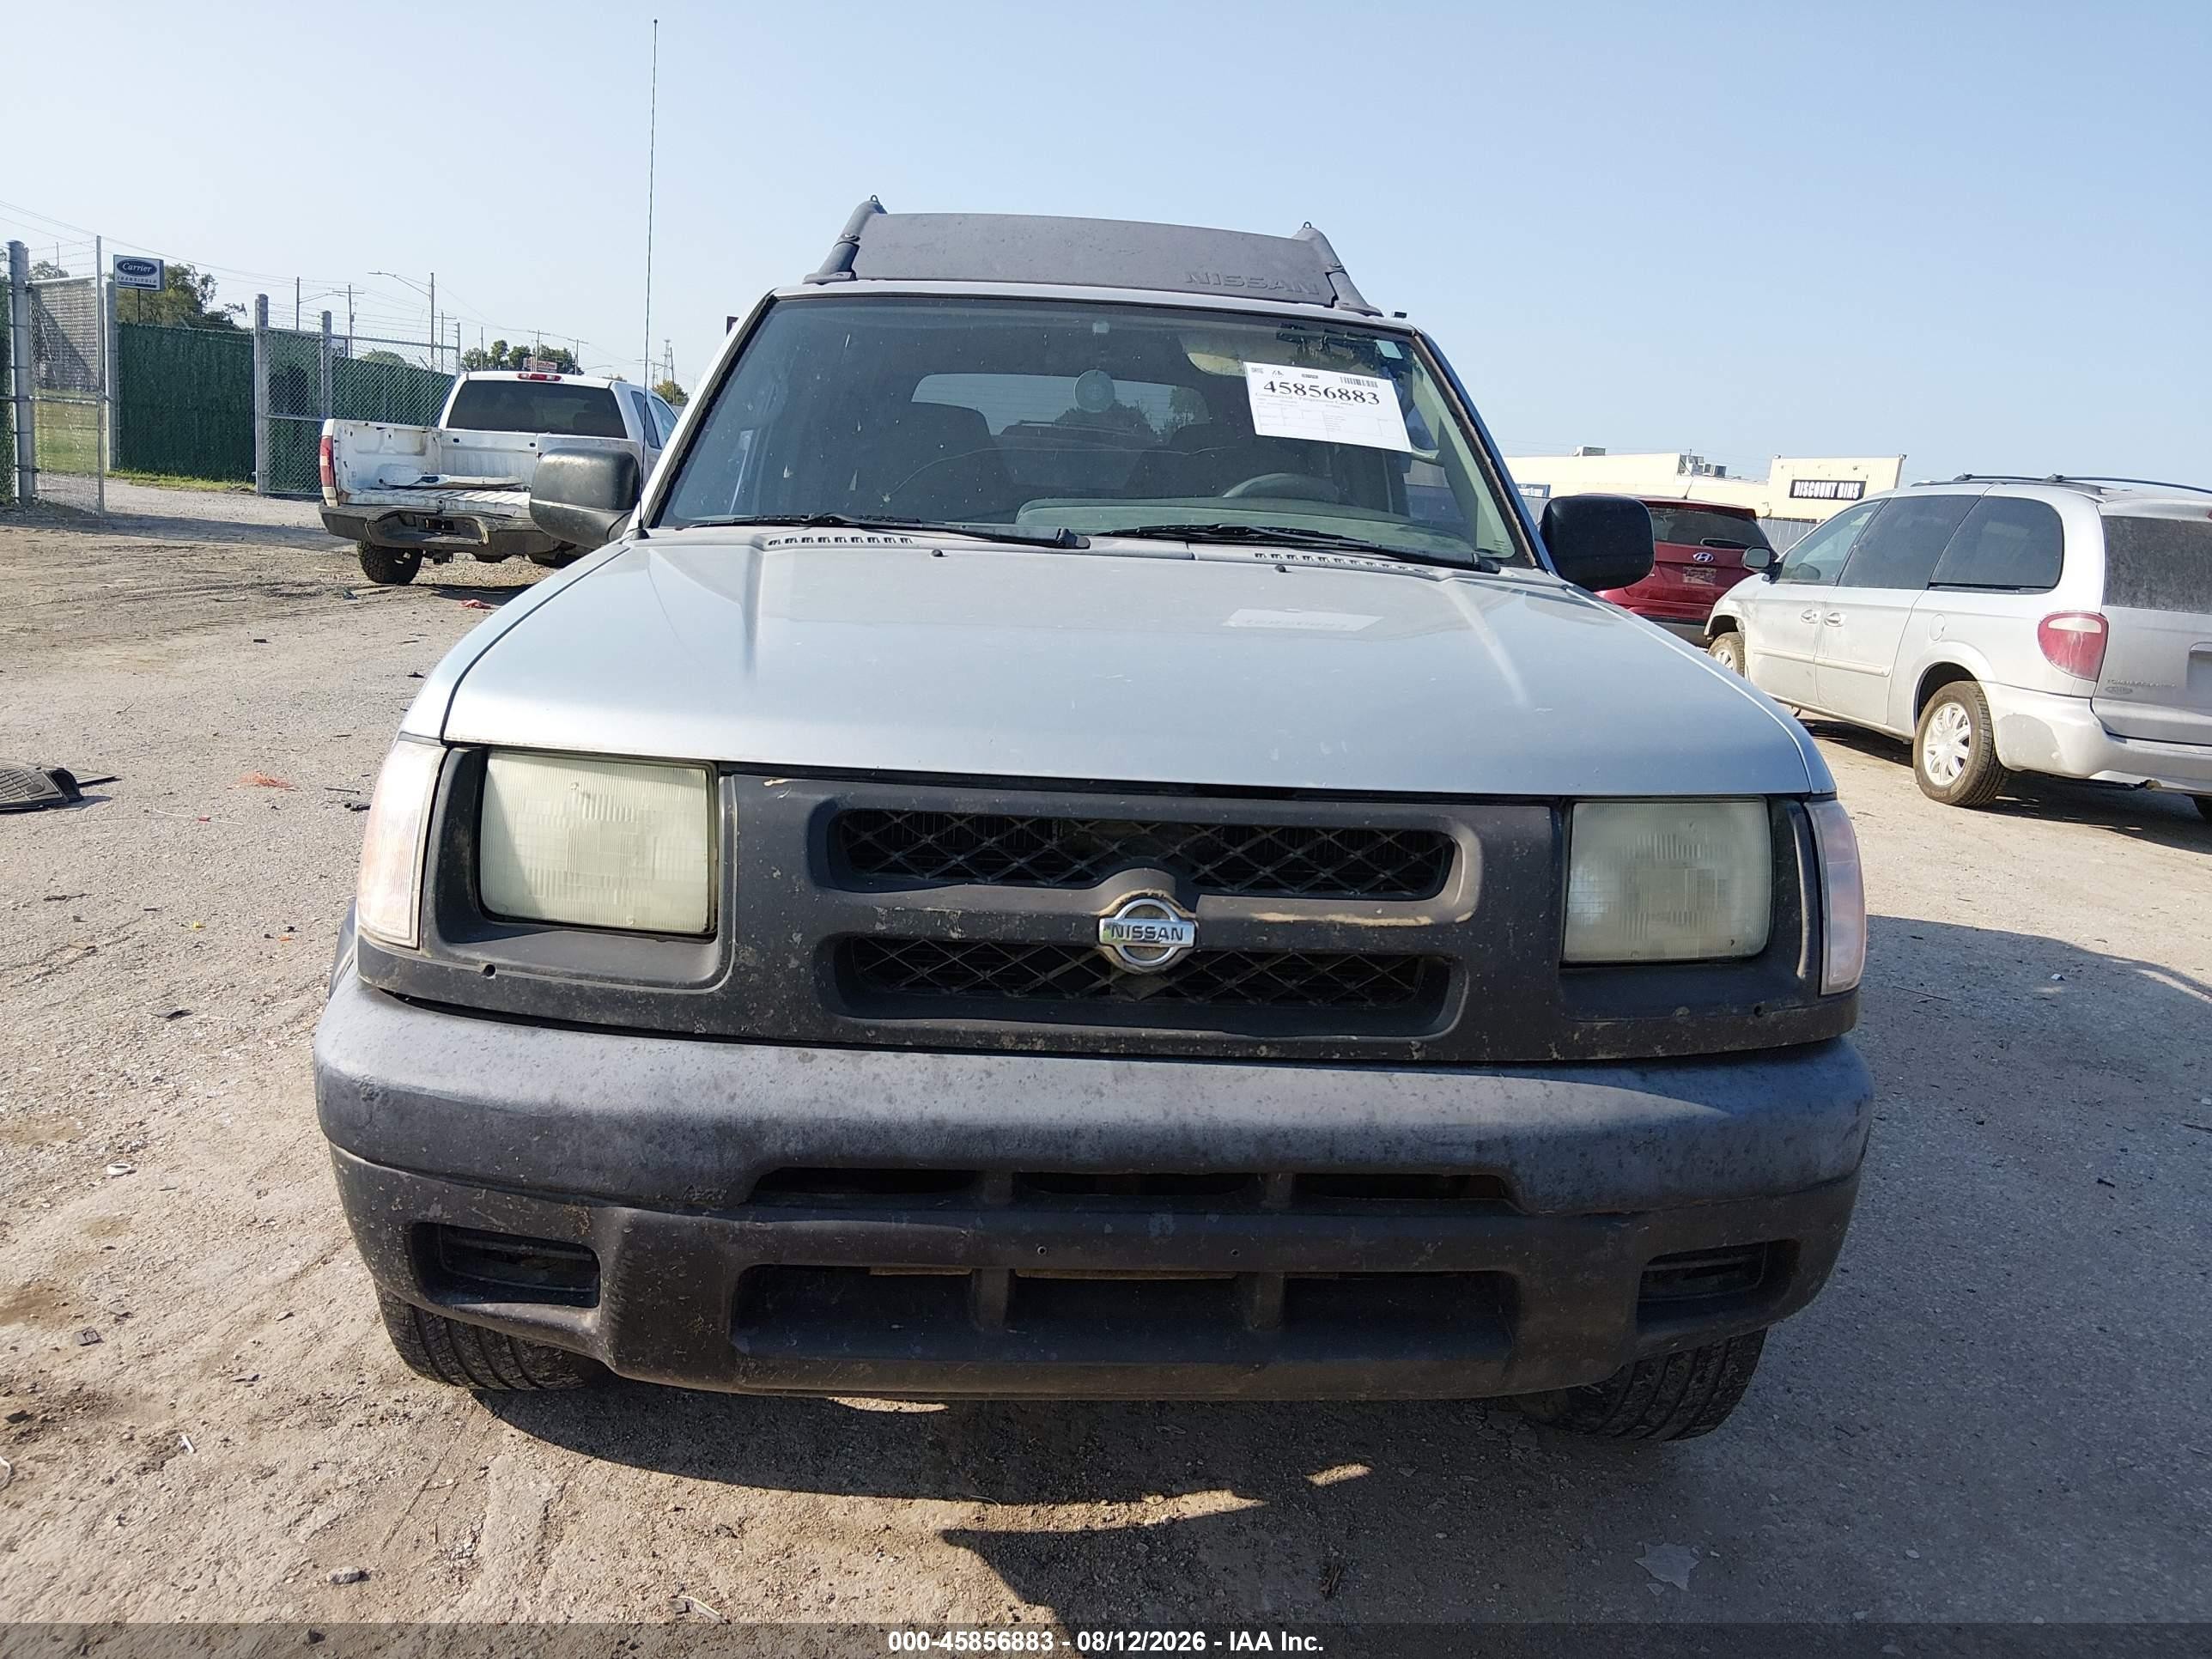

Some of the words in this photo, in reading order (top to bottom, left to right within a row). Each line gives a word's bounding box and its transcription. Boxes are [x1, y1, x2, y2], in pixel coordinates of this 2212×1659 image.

[122, 263, 152, 272] Carrier
[1186, 272, 1320, 295] NISSAN
[1263, 380, 1380, 405] 45856883
[1793, 481, 1838, 498] DISCOUNT
[1837, 483, 1861, 500] BINS
[1111, 924, 1183, 941] NISSAN
